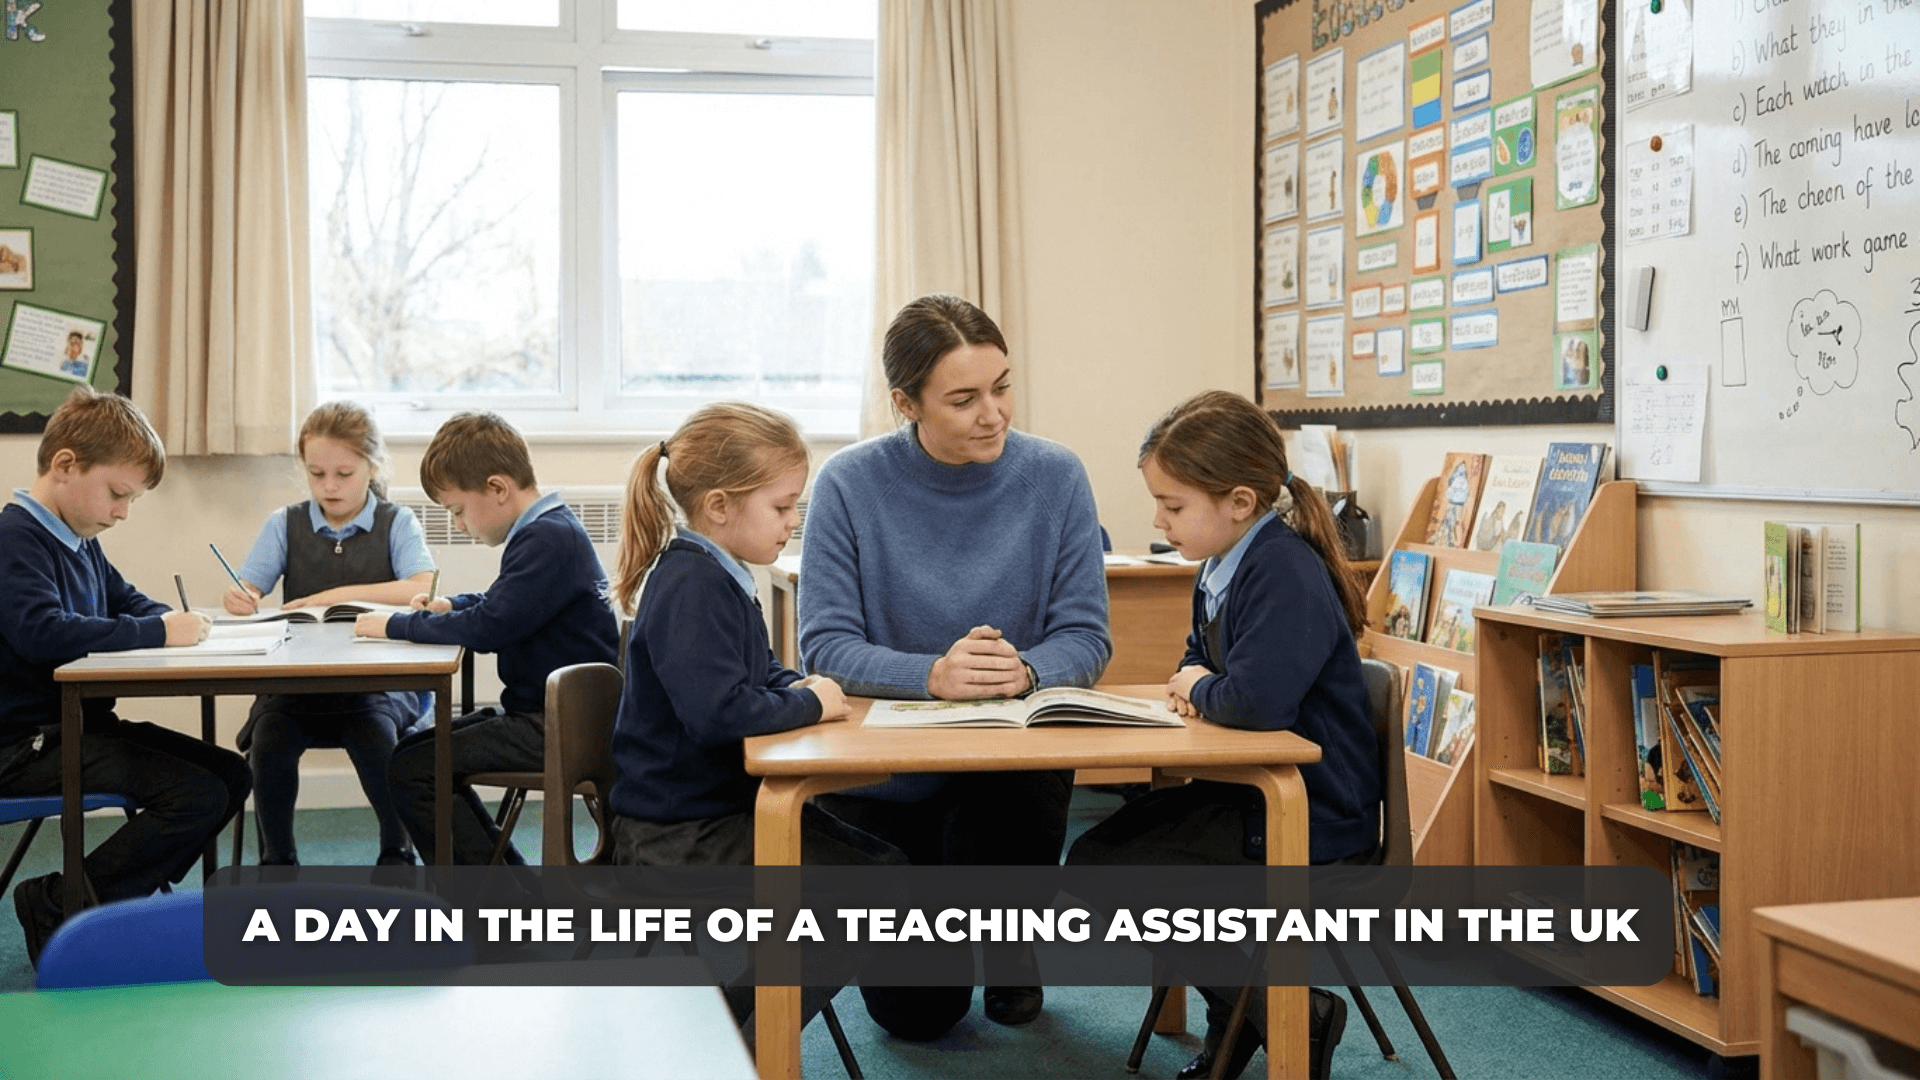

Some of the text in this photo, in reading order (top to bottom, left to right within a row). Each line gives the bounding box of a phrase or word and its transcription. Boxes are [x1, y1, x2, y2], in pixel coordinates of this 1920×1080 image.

[1755, 24, 1798, 63] What
[1809, 14, 1846, 52] they
[1858, 2, 1874, 24] in
[1757, 80, 1793, 116] Each
[1885, 41, 1912, 74] the
[1754, 139, 1781, 168] The
[1789, 128, 1842, 167] coming
[1853, 114, 1893, 142] have
[1758, 187, 1788, 218] The
[1856, 167, 1873, 209] of
[1885, 159, 1914, 189] the
[1811, 231, 1851, 262] work
[1863, 232, 1908, 273] game
